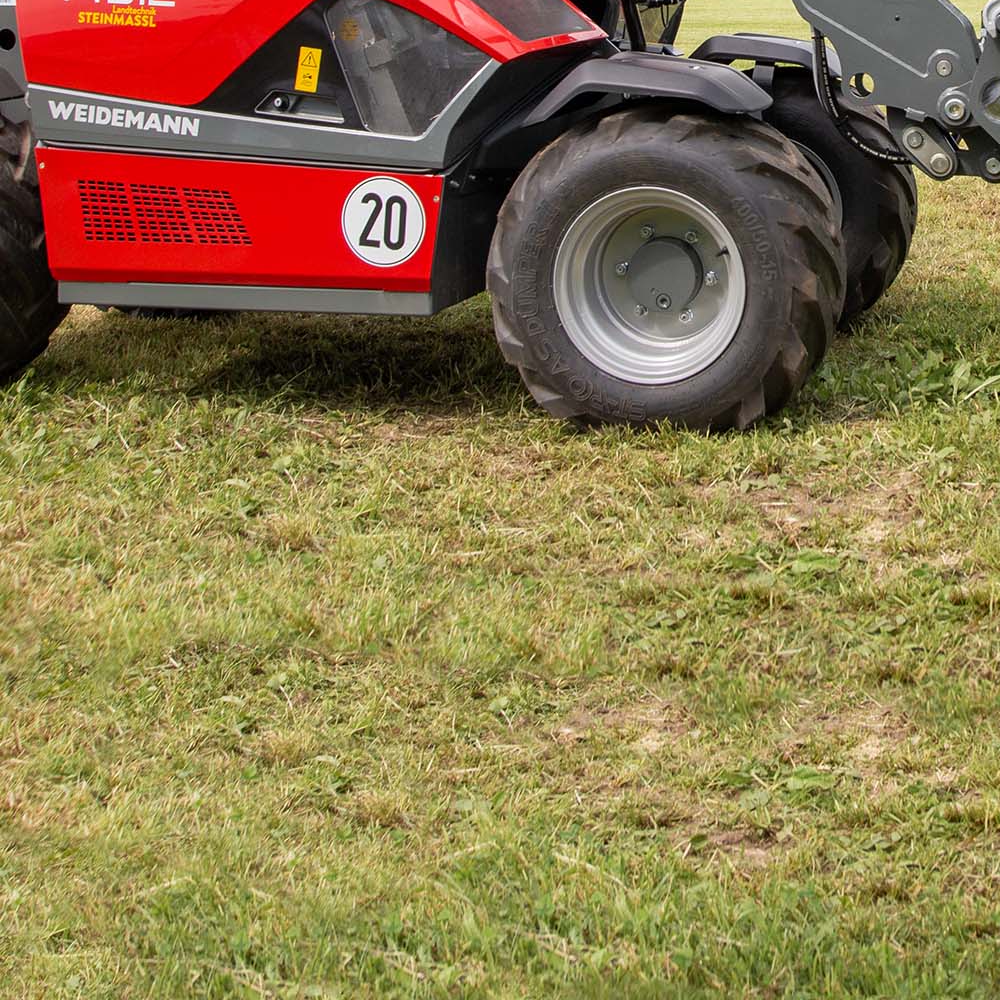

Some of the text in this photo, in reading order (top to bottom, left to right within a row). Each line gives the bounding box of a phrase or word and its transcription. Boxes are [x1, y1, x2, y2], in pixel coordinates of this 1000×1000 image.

[78, 12, 157, 28] STEINMASSL
[112, 5, 157, 15] Landtechnik
[48, 100, 200, 137] WEIDEMANN
[359, 192, 407, 250] 20
